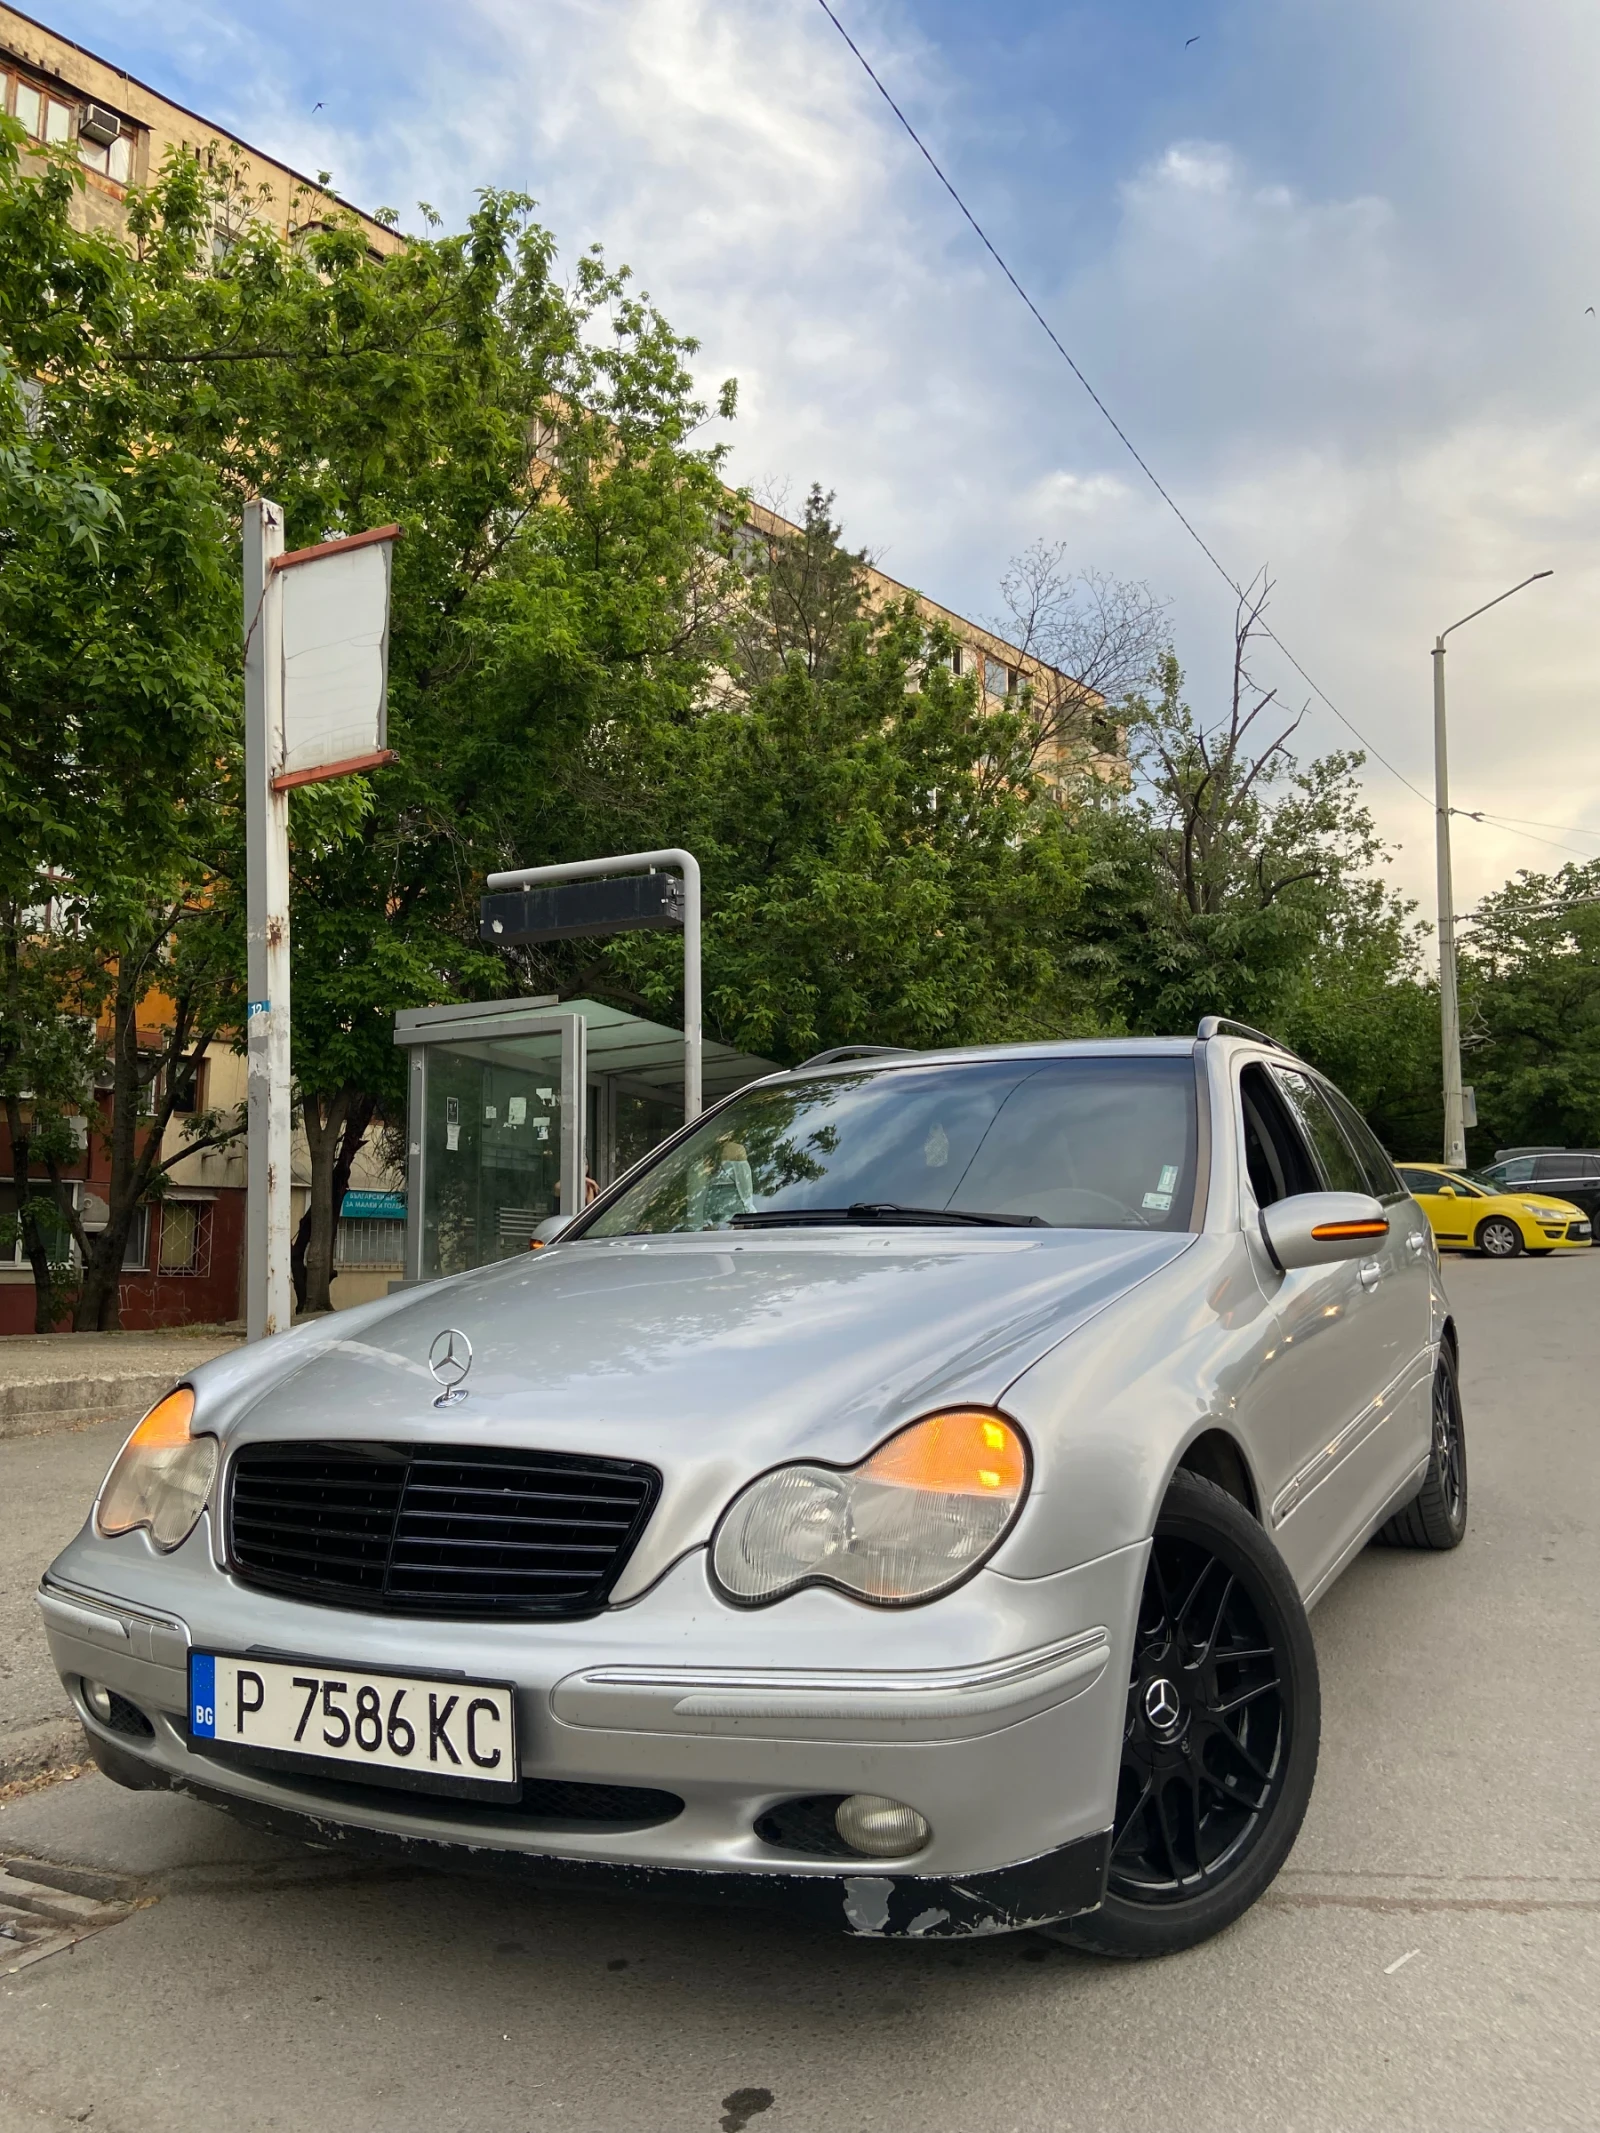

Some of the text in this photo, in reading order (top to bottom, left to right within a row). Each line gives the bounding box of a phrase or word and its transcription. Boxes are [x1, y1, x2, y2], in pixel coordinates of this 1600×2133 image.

[195, 1704, 214, 1726] BG
[236, 1669, 501, 1769] P 7586 KC
